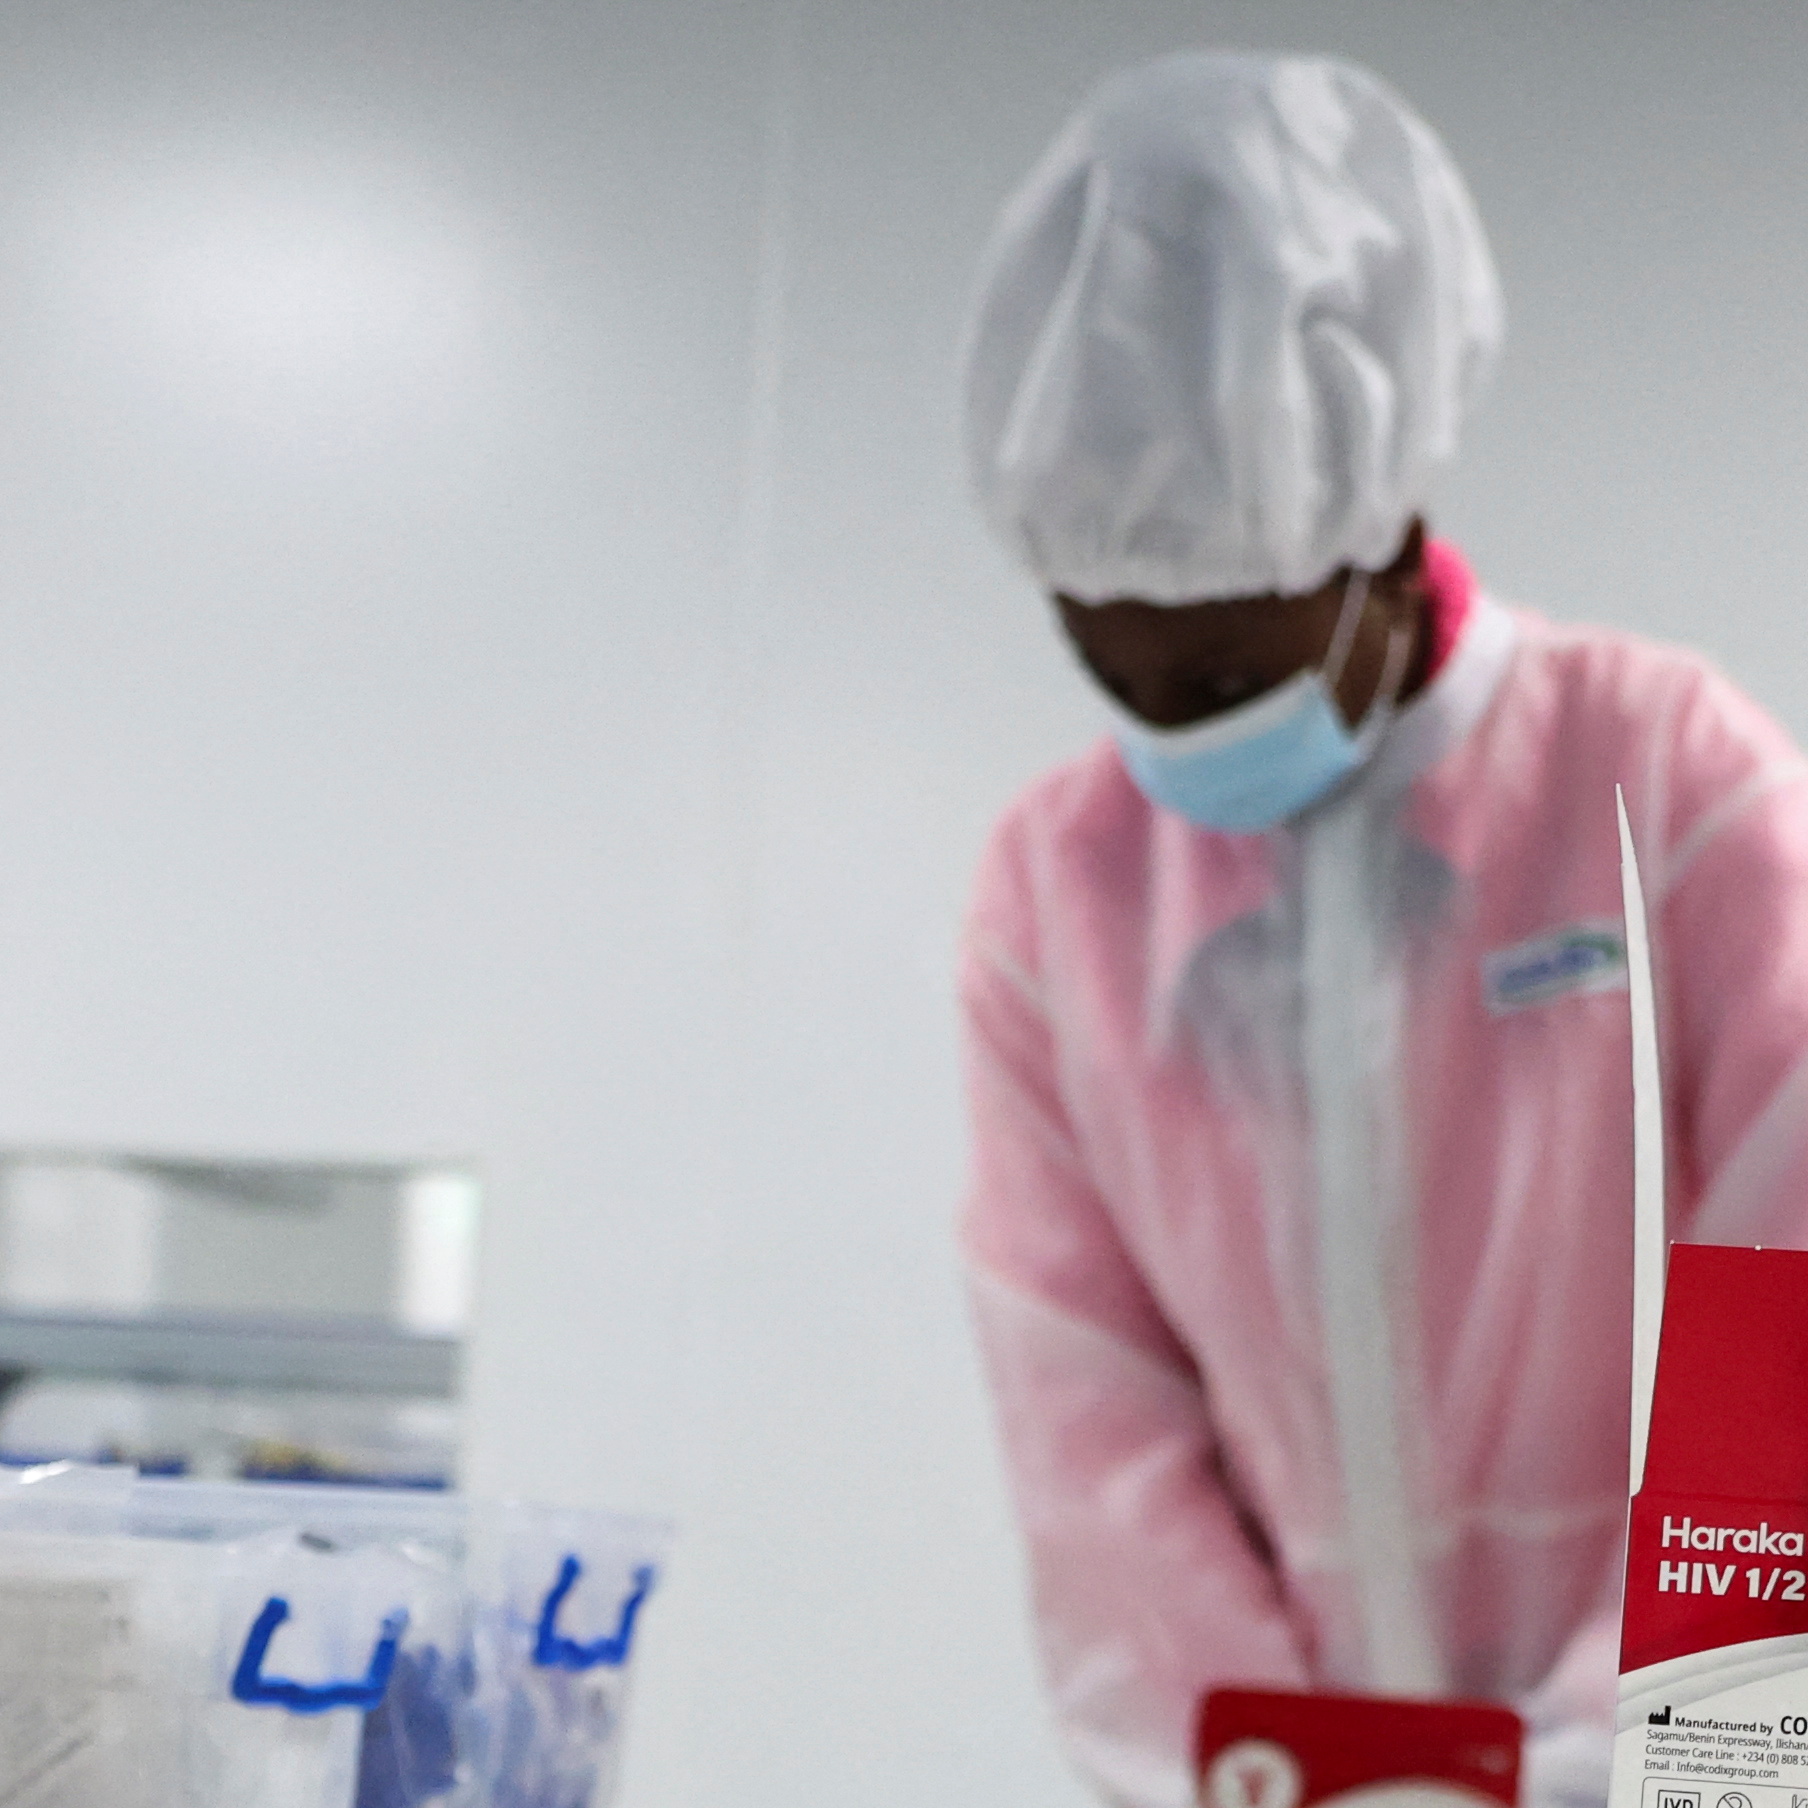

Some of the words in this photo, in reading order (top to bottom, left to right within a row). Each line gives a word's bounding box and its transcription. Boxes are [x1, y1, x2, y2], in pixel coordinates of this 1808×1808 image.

[1661, 1515, 1804, 1557] Haraka
[1658, 1560, 1737, 1596] HIV
[1745, 1567, 1807, 1601] 1/2
[1675, 1717, 1757, 1733] Manufactured
[1760, 1723, 1774, 1737] by
[1647, 1729, 1716, 1745] Sagamu/Benin
[1717, 1734, 1773, 1750] Expressway,
[1645, 1744, 1690, 1758] Customer
[1692, 1747, 1713, 1759] Care
[1715, 1749, 1735, 1761] Line
[1742, 1751, 1765, 1763] +234
[1766, 1752, 1780, 1765] (0)
[1781, 1753, 1799, 1765] 808
[1644, 1759, 1670, 1771] Email
[1677, 1762, 1779, 1779] Info@codixgroup.com
